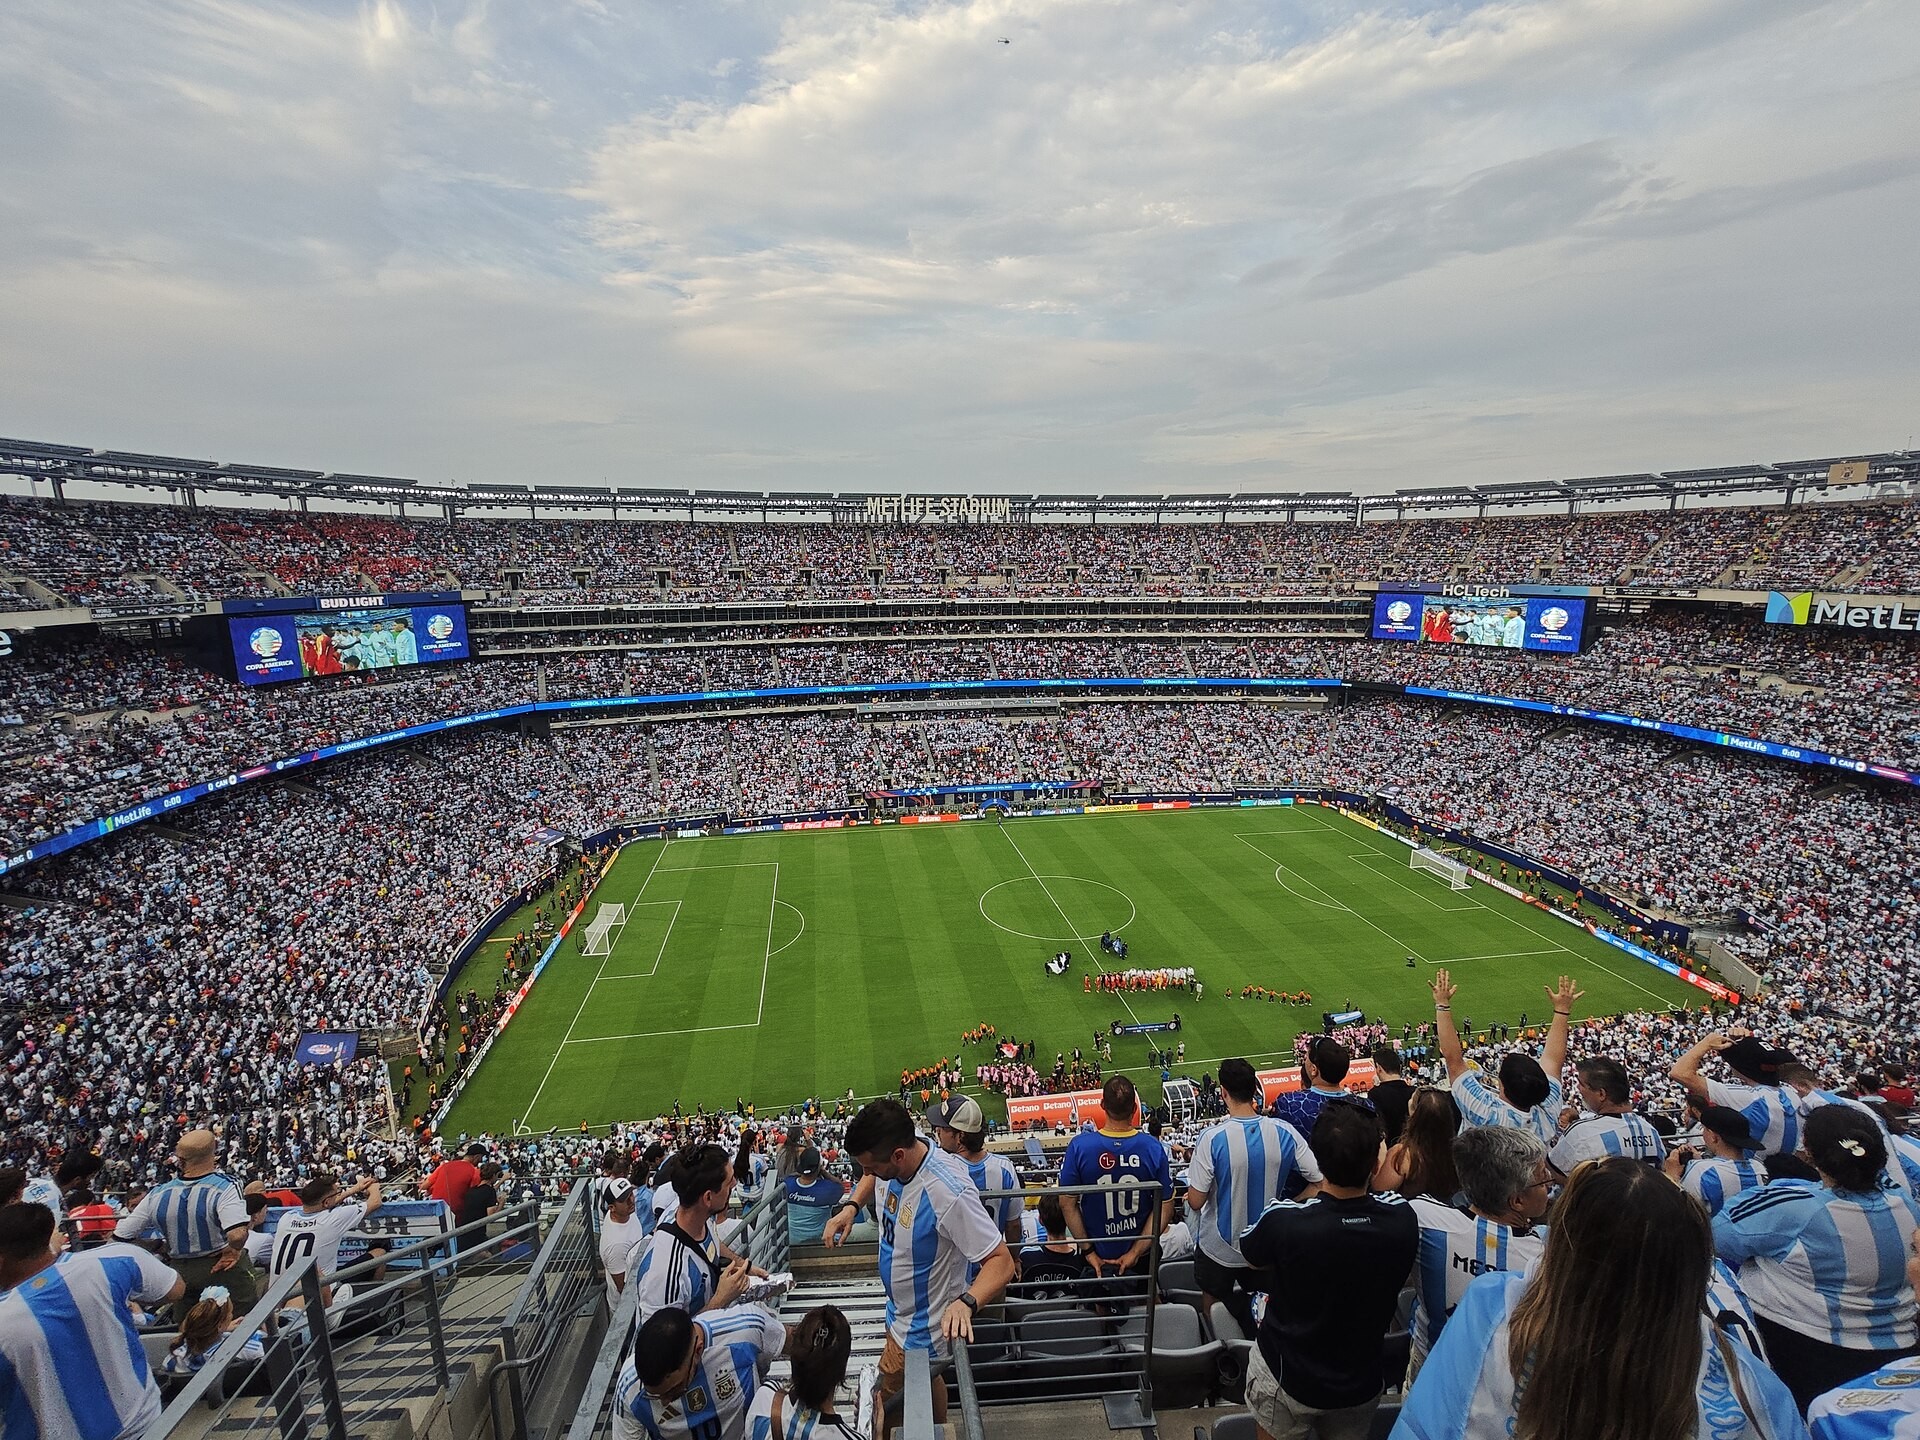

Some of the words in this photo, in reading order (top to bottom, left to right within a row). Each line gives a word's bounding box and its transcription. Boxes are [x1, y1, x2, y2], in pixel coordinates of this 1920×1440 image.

[867, 497, 934, 516] METLIFE
[940, 497, 1010, 516] STADIUM
[1442, 584, 1510, 598] HCLTech
[320, 598, 348, 608] BUD
[350, 596, 384, 607] LIGHT
[246, 662, 264, 671] COPA
[264, 660, 294, 669] AMERICA
[1447, 692, 1475, 700] CONMEBOL
[446, 717, 472, 727] CONMEBOL
[336, 740, 368, 752] CONMEBOL
[1730, 737, 1767, 752] MetLife
[1782, 749, 1800, 758] 0:00
[1838, 760, 1855, 768] CAN
[208, 782, 214, 791] 0
[215, 780, 228, 788] CAN
[163, 795, 181, 807] 0:00
[115, 806, 152, 827] MetLife
[677, 830, 700, 838] PUMA
[8, 855, 25, 868] ARG
[27, 850, 33, 860] 0
[1262, 1076, 1289, 1085] Betano
[1044, 1102, 1072, 1110] Betano
[1078, 1098, 1102, 1106] Betan
[1011, 1105, 1039, 1113] Betano
[1623, 1136, 1653, 1148] MESSI
[1120, 1154, 1140, 1167] LG
[1097, 1174, 1140, 1219] 10
[291, 1219, 317, 1228] MESSI
[1105, 1217, 1136, 1235] ROMAN
[882, 1213, 895, 1248] 10
[274, 1232, 316, 1275] 10
